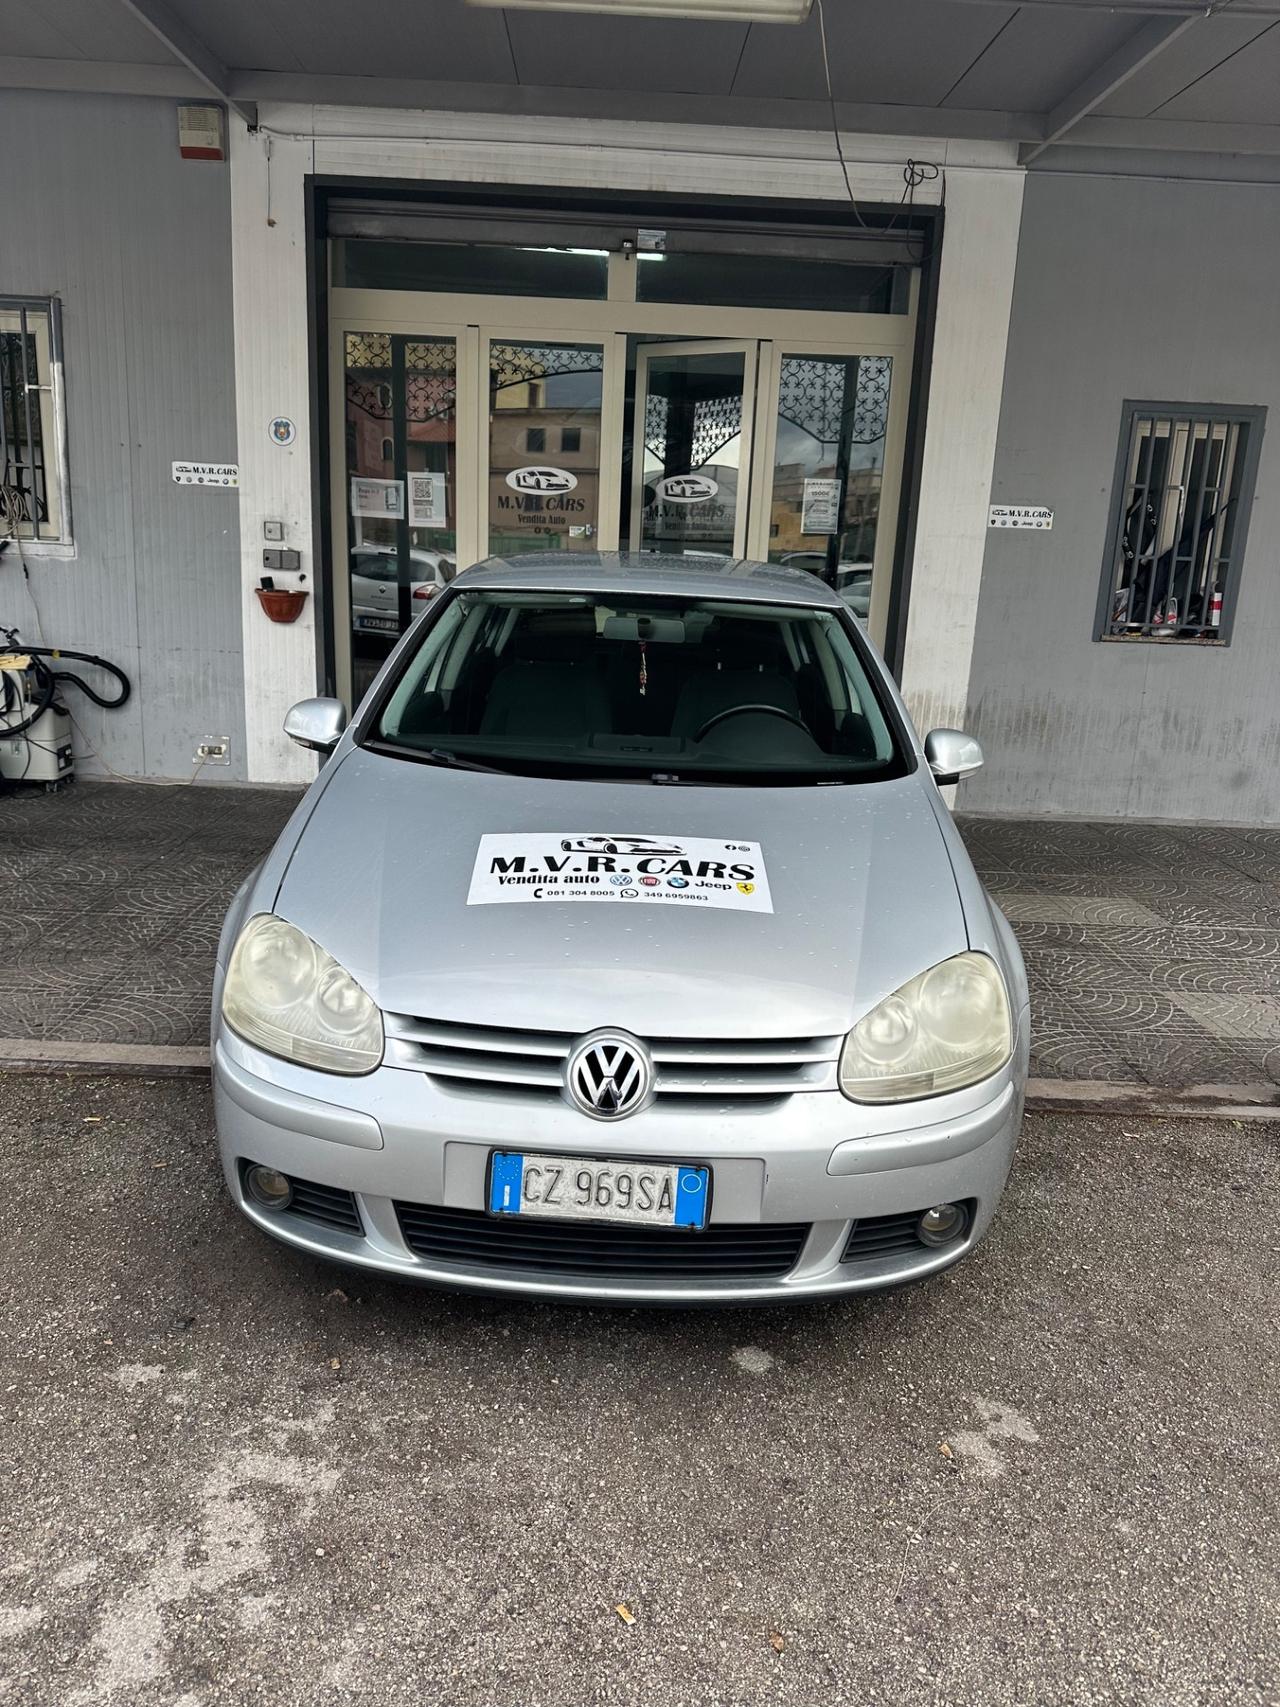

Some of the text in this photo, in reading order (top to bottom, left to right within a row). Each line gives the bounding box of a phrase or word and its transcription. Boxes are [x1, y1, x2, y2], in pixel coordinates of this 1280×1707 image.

[518, 514, 566, 524] Vendita Auto
[498, 874, 559, 886] Vendita
[563, 874, 601, 884] auto
[694, 880, 733, 891] Jeep
[664, 892, 709, 901] 6959863
[522, 1166, 675, 1215] CZ 969SA
